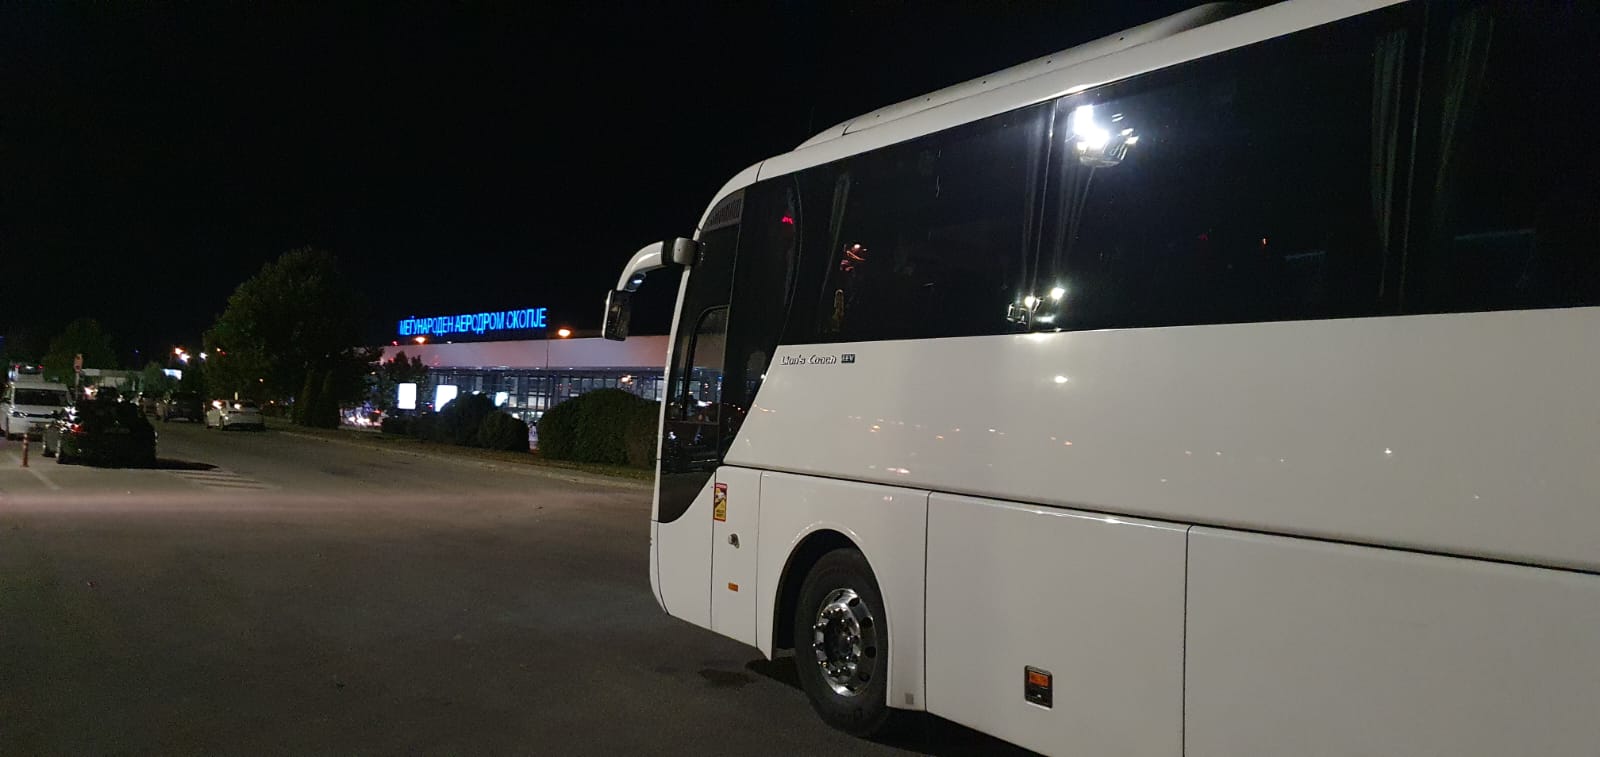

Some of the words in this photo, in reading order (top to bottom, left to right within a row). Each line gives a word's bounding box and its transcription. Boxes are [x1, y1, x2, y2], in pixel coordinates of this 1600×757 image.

[399, 315, 454, 336] МЕЃУНАРОДЕН
[454, 311, 505, 335] АЕРОДРОМ
[506, 308, 547, 328] СКОПЈЕ
